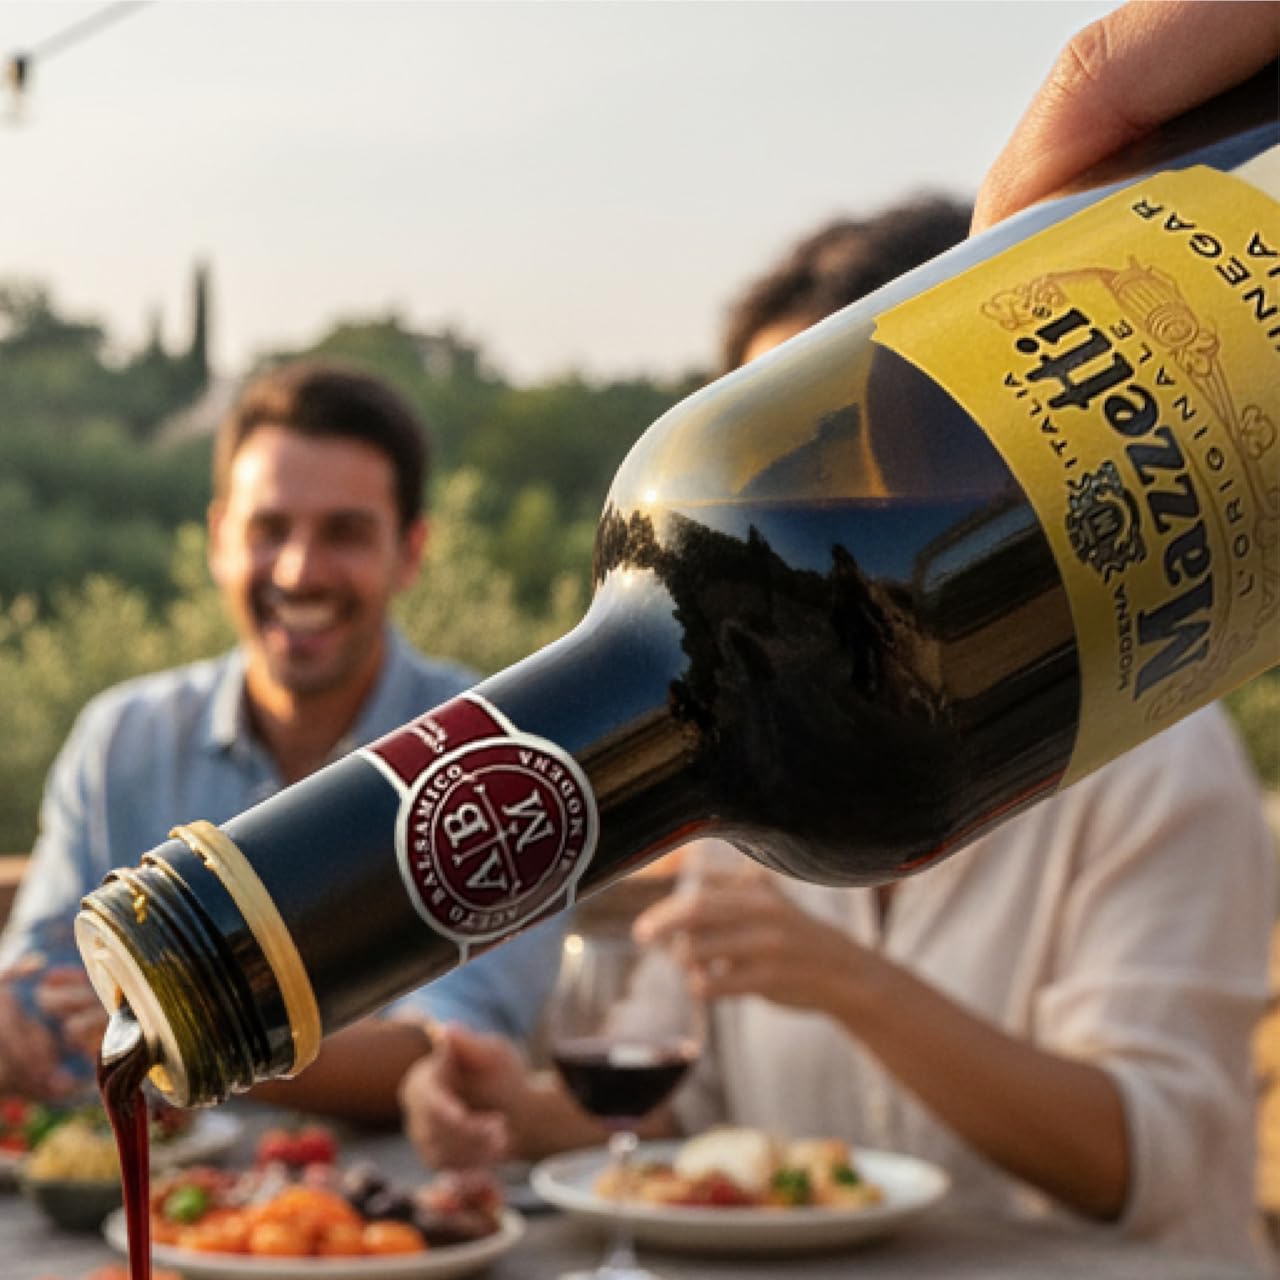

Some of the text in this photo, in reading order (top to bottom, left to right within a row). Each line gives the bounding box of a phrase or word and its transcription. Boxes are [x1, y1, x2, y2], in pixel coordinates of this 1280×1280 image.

[1004, 372, 1077, 469] ITALIA
[1015, 309, 1213, 701] Mazzetti
[1110, 320, 1255, 597] L'ORIGINALE
[414, 763, 463, 906] BALSAMICO
